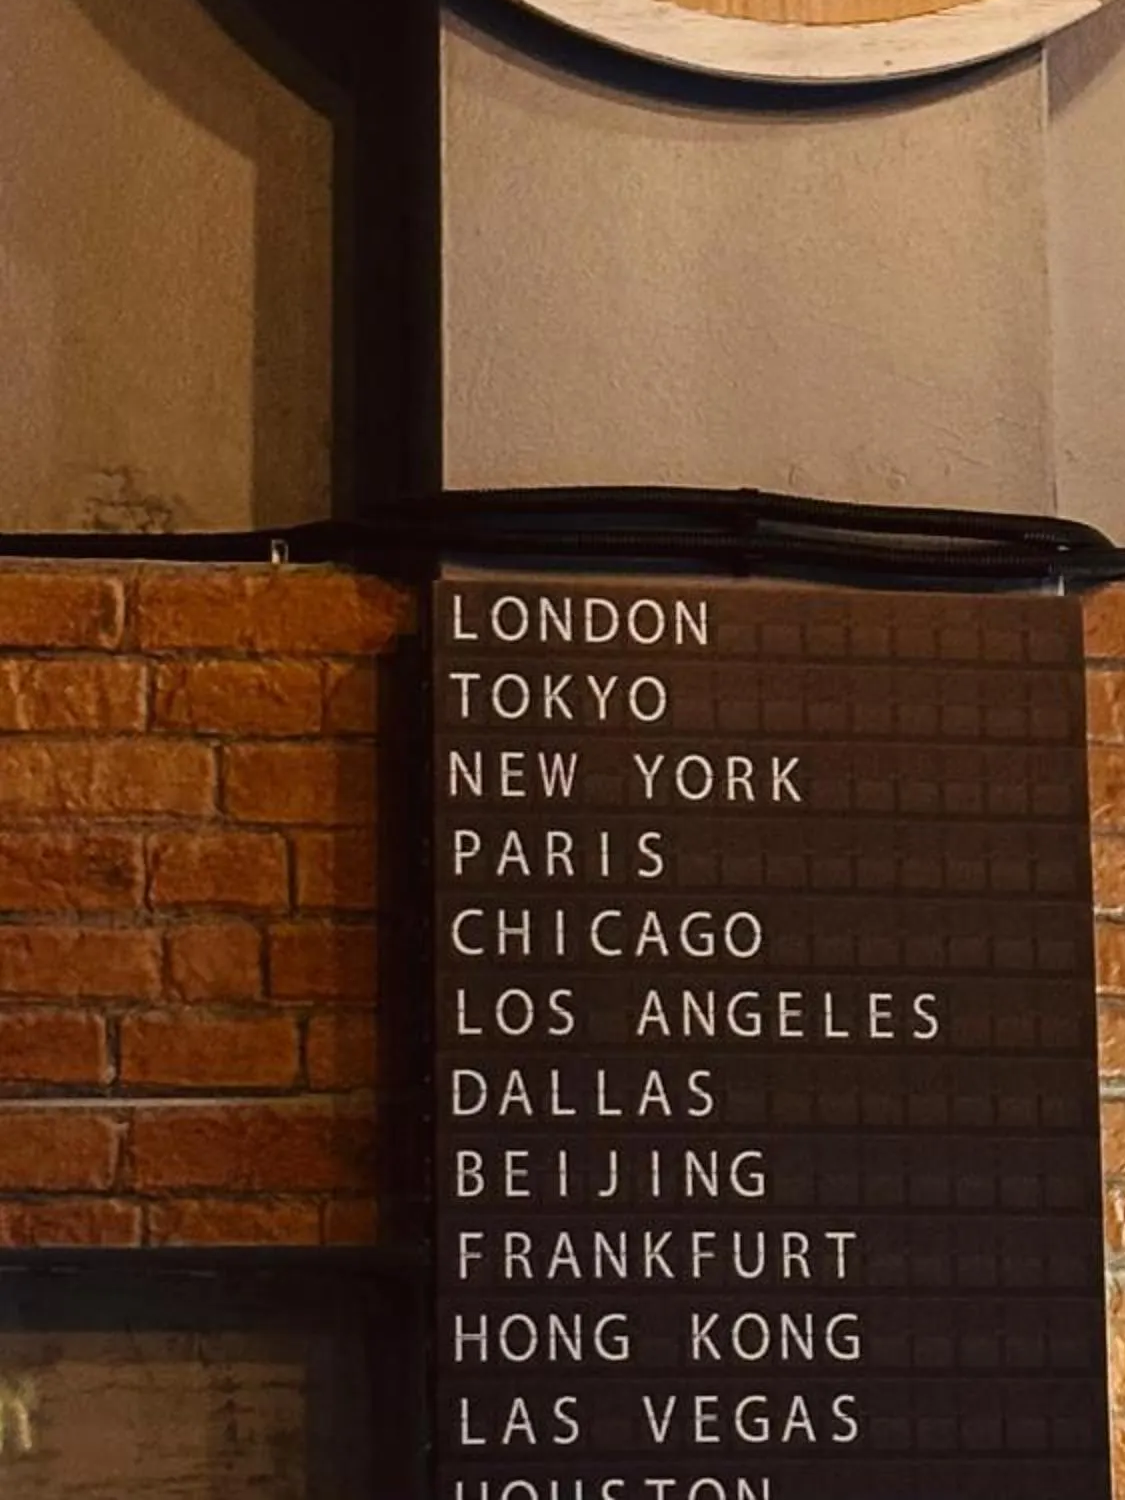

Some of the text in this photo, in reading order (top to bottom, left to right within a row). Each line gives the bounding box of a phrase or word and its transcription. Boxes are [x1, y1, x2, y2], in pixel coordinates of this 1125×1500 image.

[452, 594, 708, 646] LONDON
[448, 672, 667, 722] TOKYO
[448, 750, 802, 802] NEW YORK
[453, 829, 665, 878] PARIS
[451, 908, 763, 958] CHICAGO
[457, 988, 939, 1040] LOS ANGELES
[452, 1069, 714, 1117] DALLAS
[456, 1150, 766, 1198] BEIJING
[458, 1231, 857, 1280] FRANKFURT
[454, 1312, 861, 1362] HONG KONG
[460, 1394, 858, 1445] LAS VEGAS
